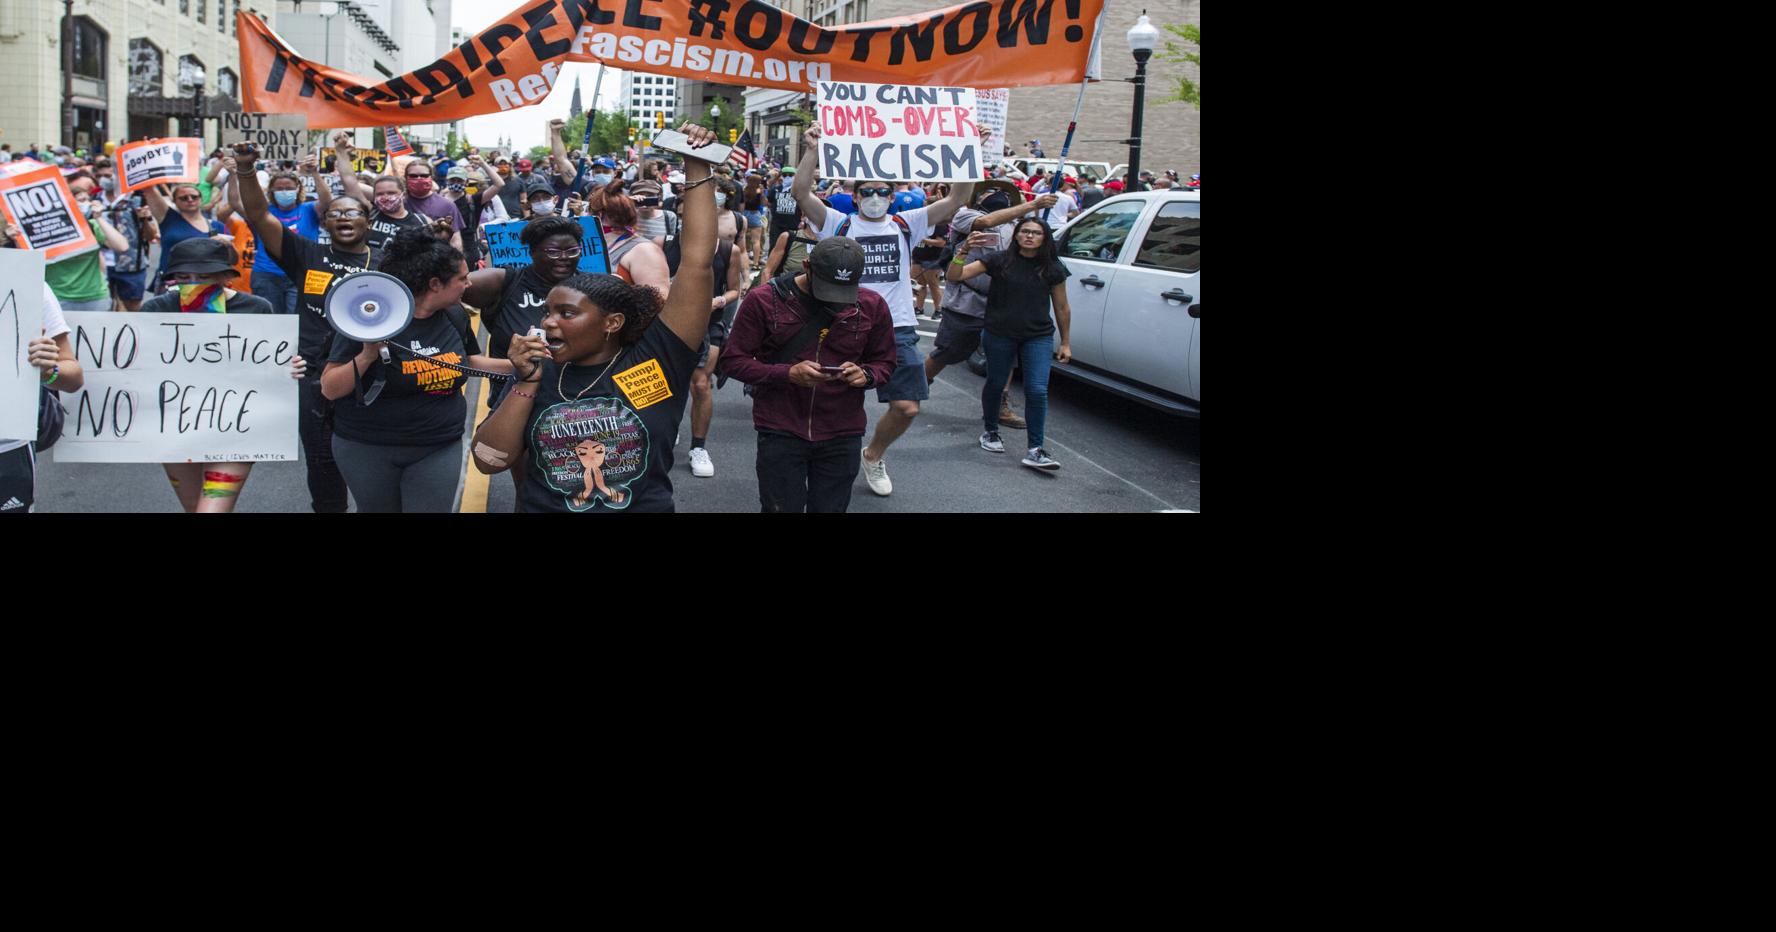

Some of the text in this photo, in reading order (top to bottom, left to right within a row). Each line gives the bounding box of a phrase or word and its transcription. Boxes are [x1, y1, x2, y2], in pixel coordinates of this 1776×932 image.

[688, 0, 1084, 66] #OUTNOW!
[820, 82, 966, 106] YOU CAN'T
[225, 112, 267, 129] NOT
[823, 142, 979, 180] RACISM
[9, 184, 63, 219] NO!
[488, 231, 505, 245] IF
[862, 243, 896, 253] BLACK
[865, 255, 895, 264] WALL
[862, 265, 899, 275] STREET
[519, 291, 545, 308] JU
[75, 323, 293, 369] NO Justice
[616, 361, 656, 384] Trump/
[625, 372, 660, 390] Pence
[628, 385, 651, 399] MUST
[653, 379, 666, 390] GO!
[76, 380, 258, 437] NO PEACE
[551, 415, 619, 440] JUNETEENTH
[621, 431, 640, 441] TEXAS
[253, 452, 286, 461] MATTER
[548, 450, 577, 460] BLACK
[556, 472, 584, 481] FESTIVAL
[603, 463, 637, 477] FREEDOM
